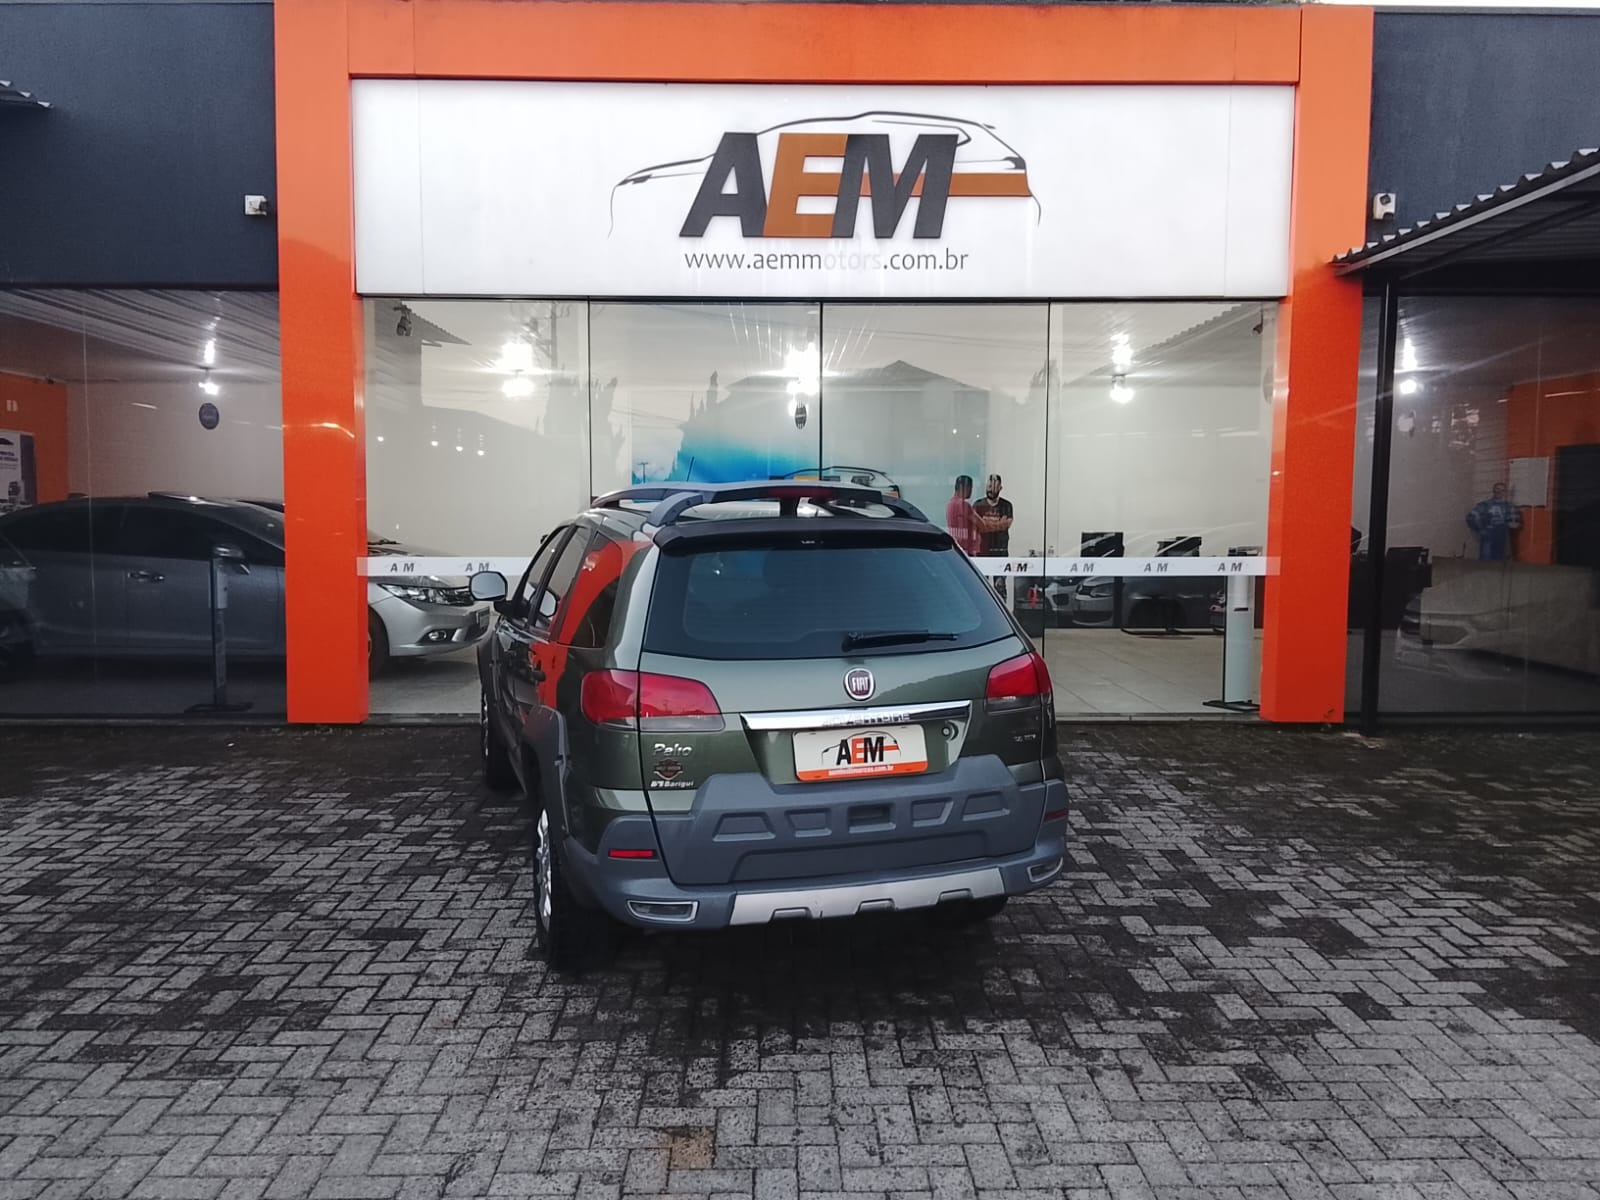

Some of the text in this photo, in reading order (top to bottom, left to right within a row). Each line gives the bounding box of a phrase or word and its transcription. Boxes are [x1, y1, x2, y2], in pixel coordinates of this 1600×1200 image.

[679, 132, 958, 239] AEM
[684, 247, 969, 271] www.aemmotors.com.br
[852, 676, 869, 691] FIAT
[836, 736, 884, 766] AEM
